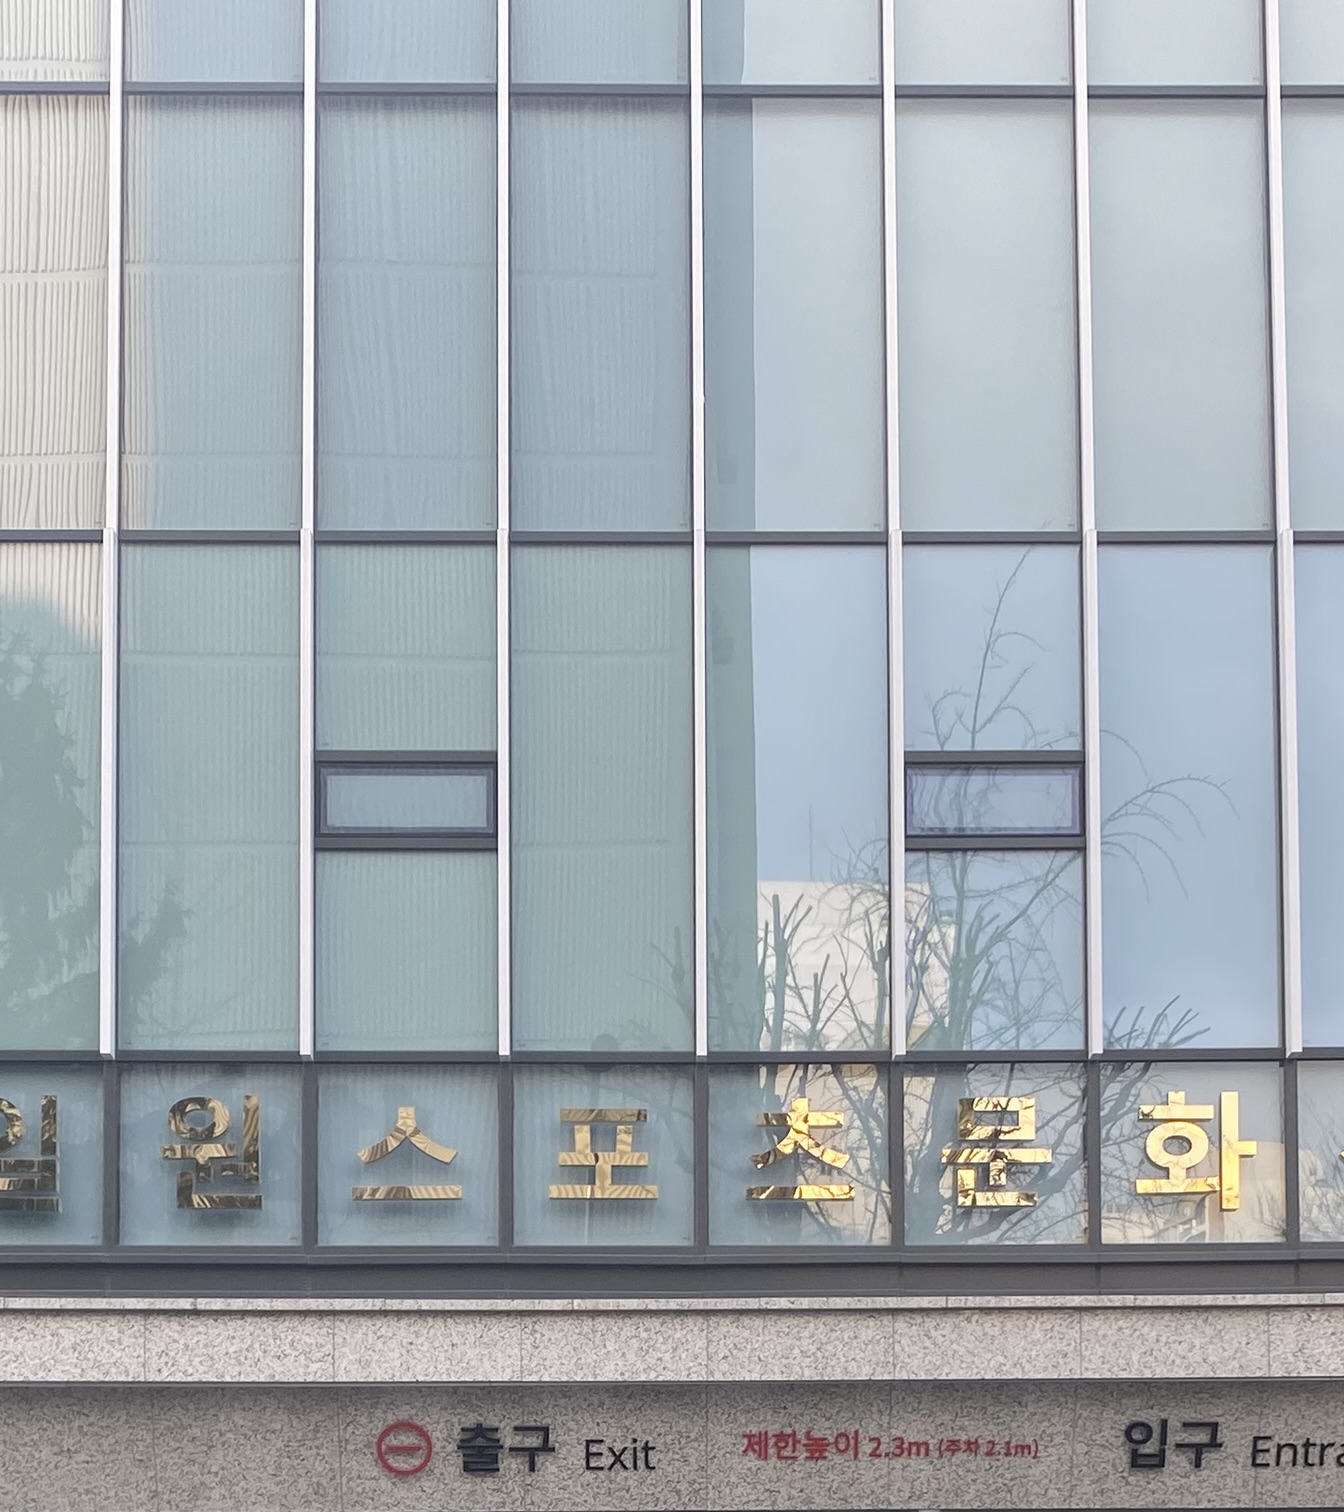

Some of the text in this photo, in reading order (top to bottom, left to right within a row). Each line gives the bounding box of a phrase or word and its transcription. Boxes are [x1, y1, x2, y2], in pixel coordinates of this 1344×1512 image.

[456, 1422, 656, 1473] 출구 Exit
[742, 1429, 1039, 1461] 제한높이 2.3m (주차 2.1m)
[1123, 1418, 1224, 1469] 입구
